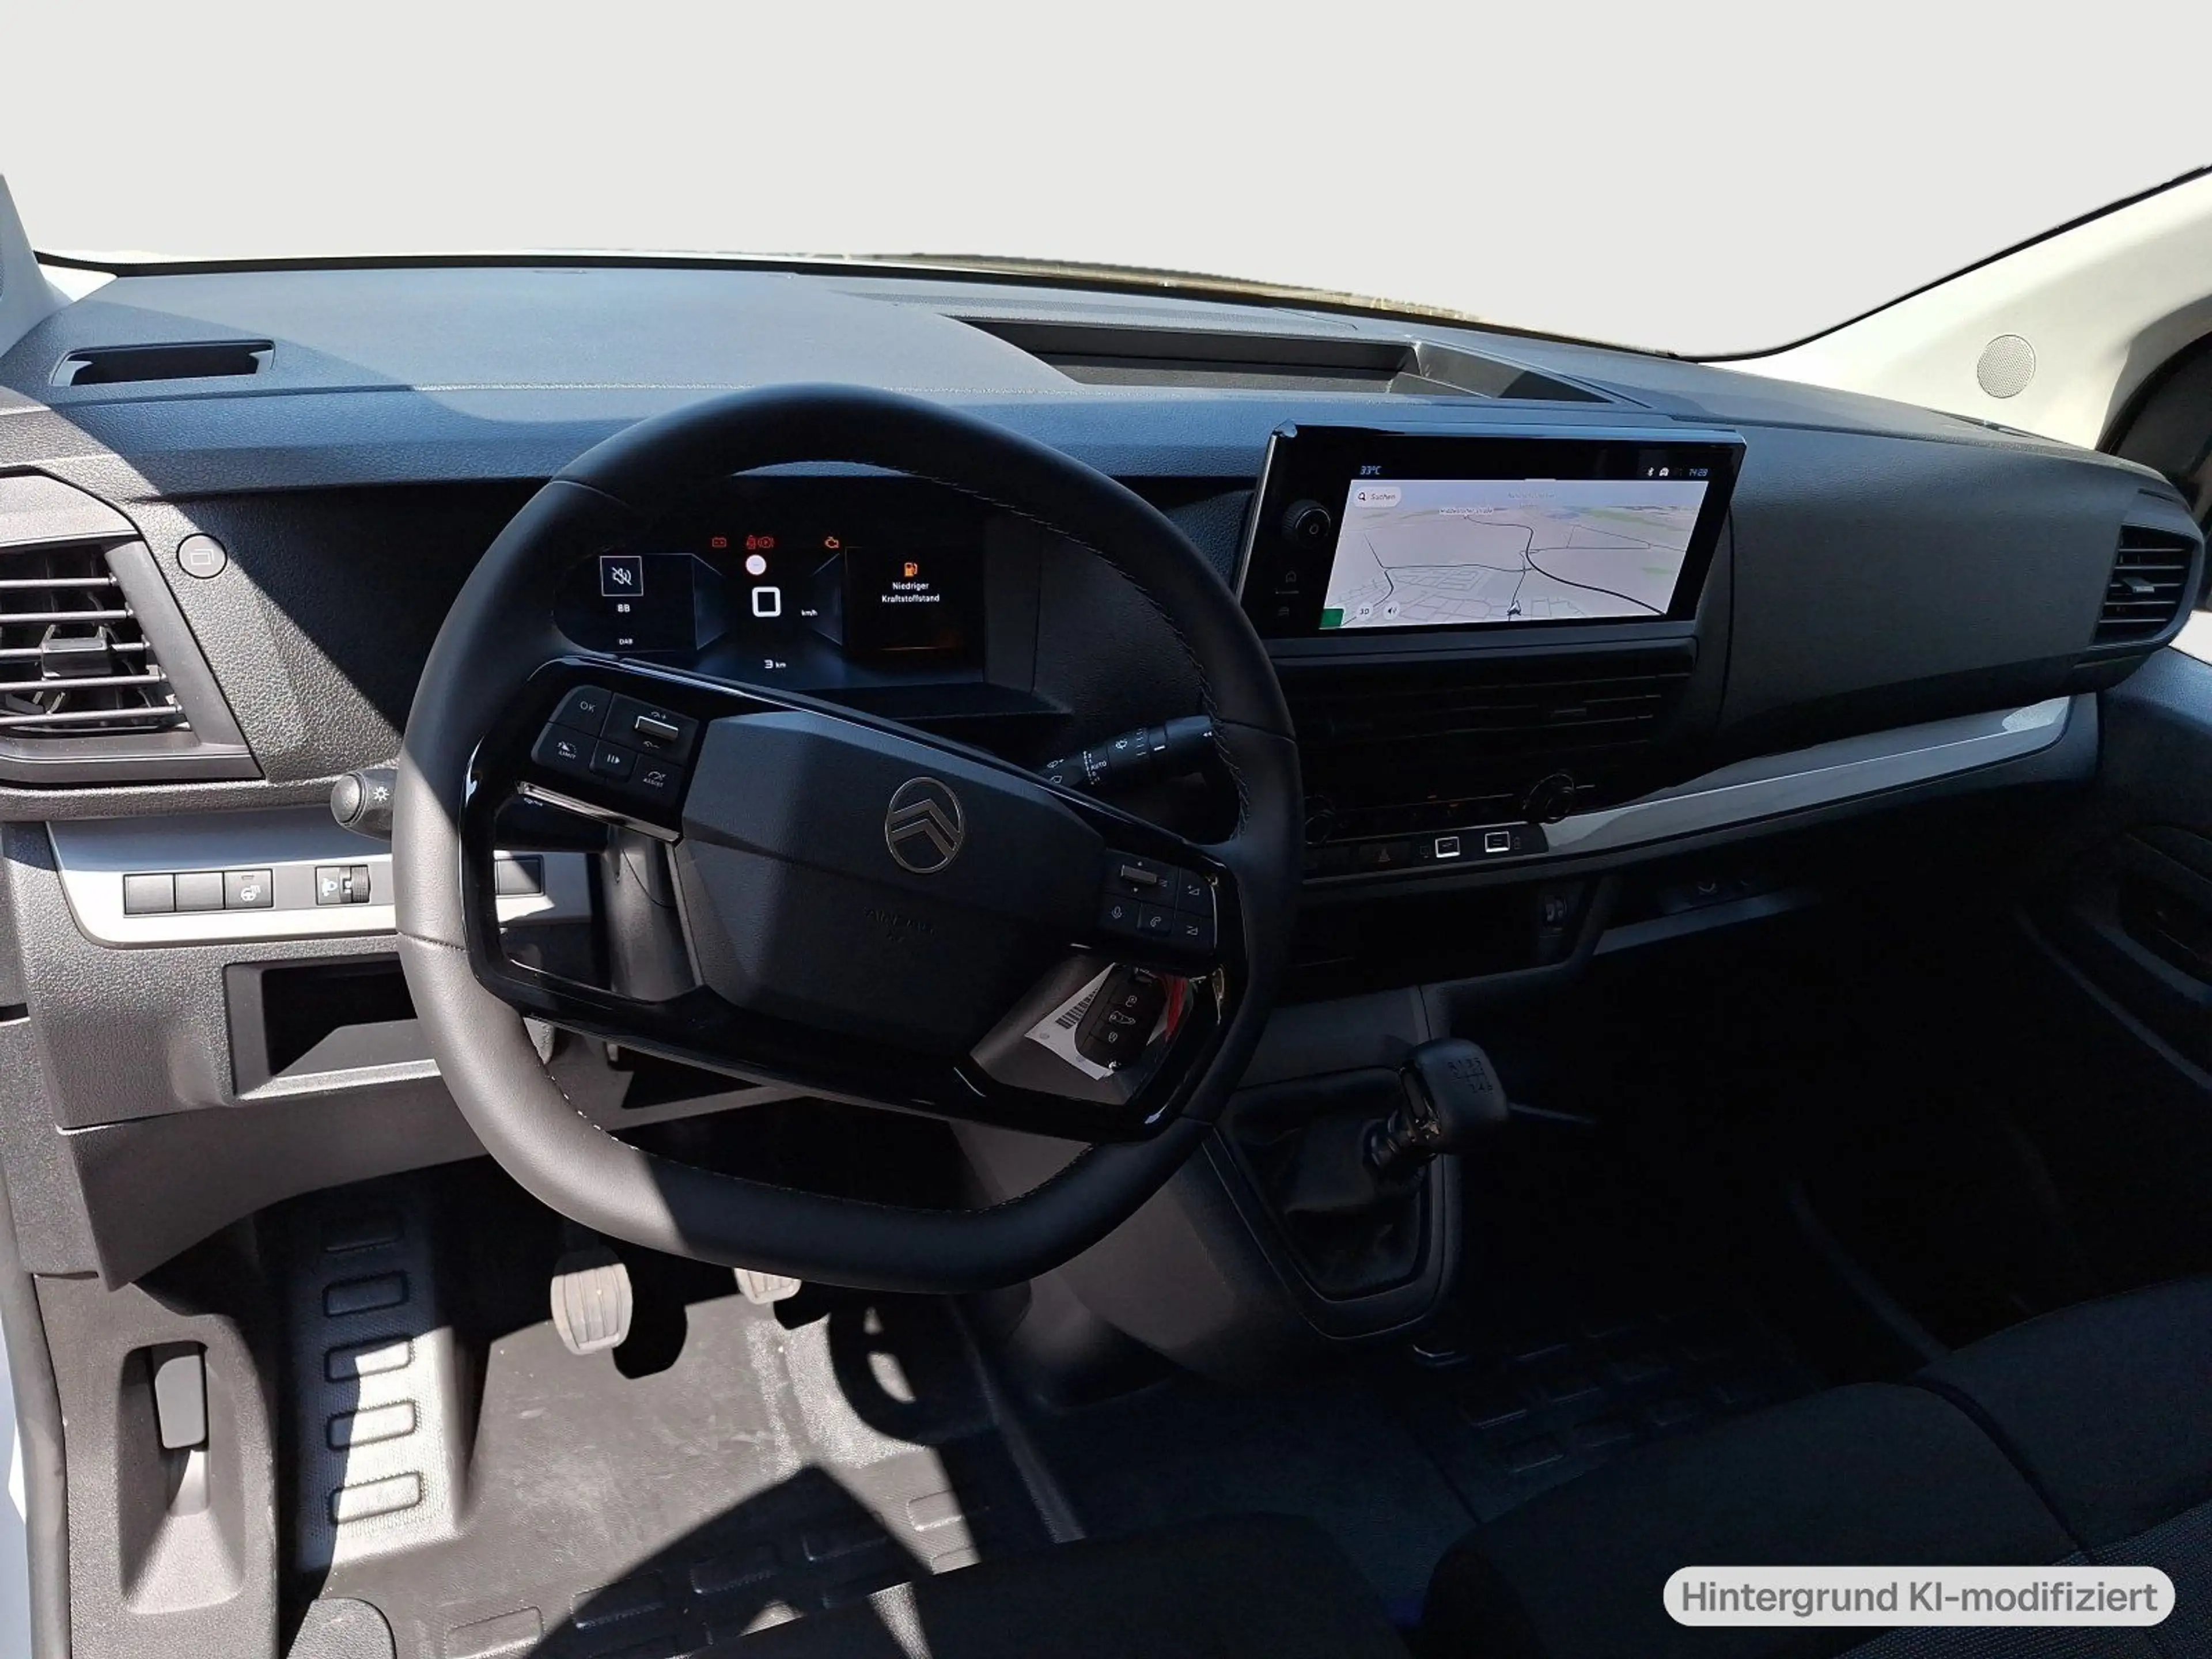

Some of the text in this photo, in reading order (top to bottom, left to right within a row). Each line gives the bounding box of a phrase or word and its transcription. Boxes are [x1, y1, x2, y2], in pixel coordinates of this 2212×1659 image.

[1360, 465, 1382, 475] 33°C
[892, 582, 929, 591] Niedriger
[752, 586, 781, 617] 0
[882, 594, 940, 603] Kraftstoffstand
[764, 659, 774, 669] 3
[580, 700, 596, 713] OK
[1091, 760, 1107, 770] AUTO
